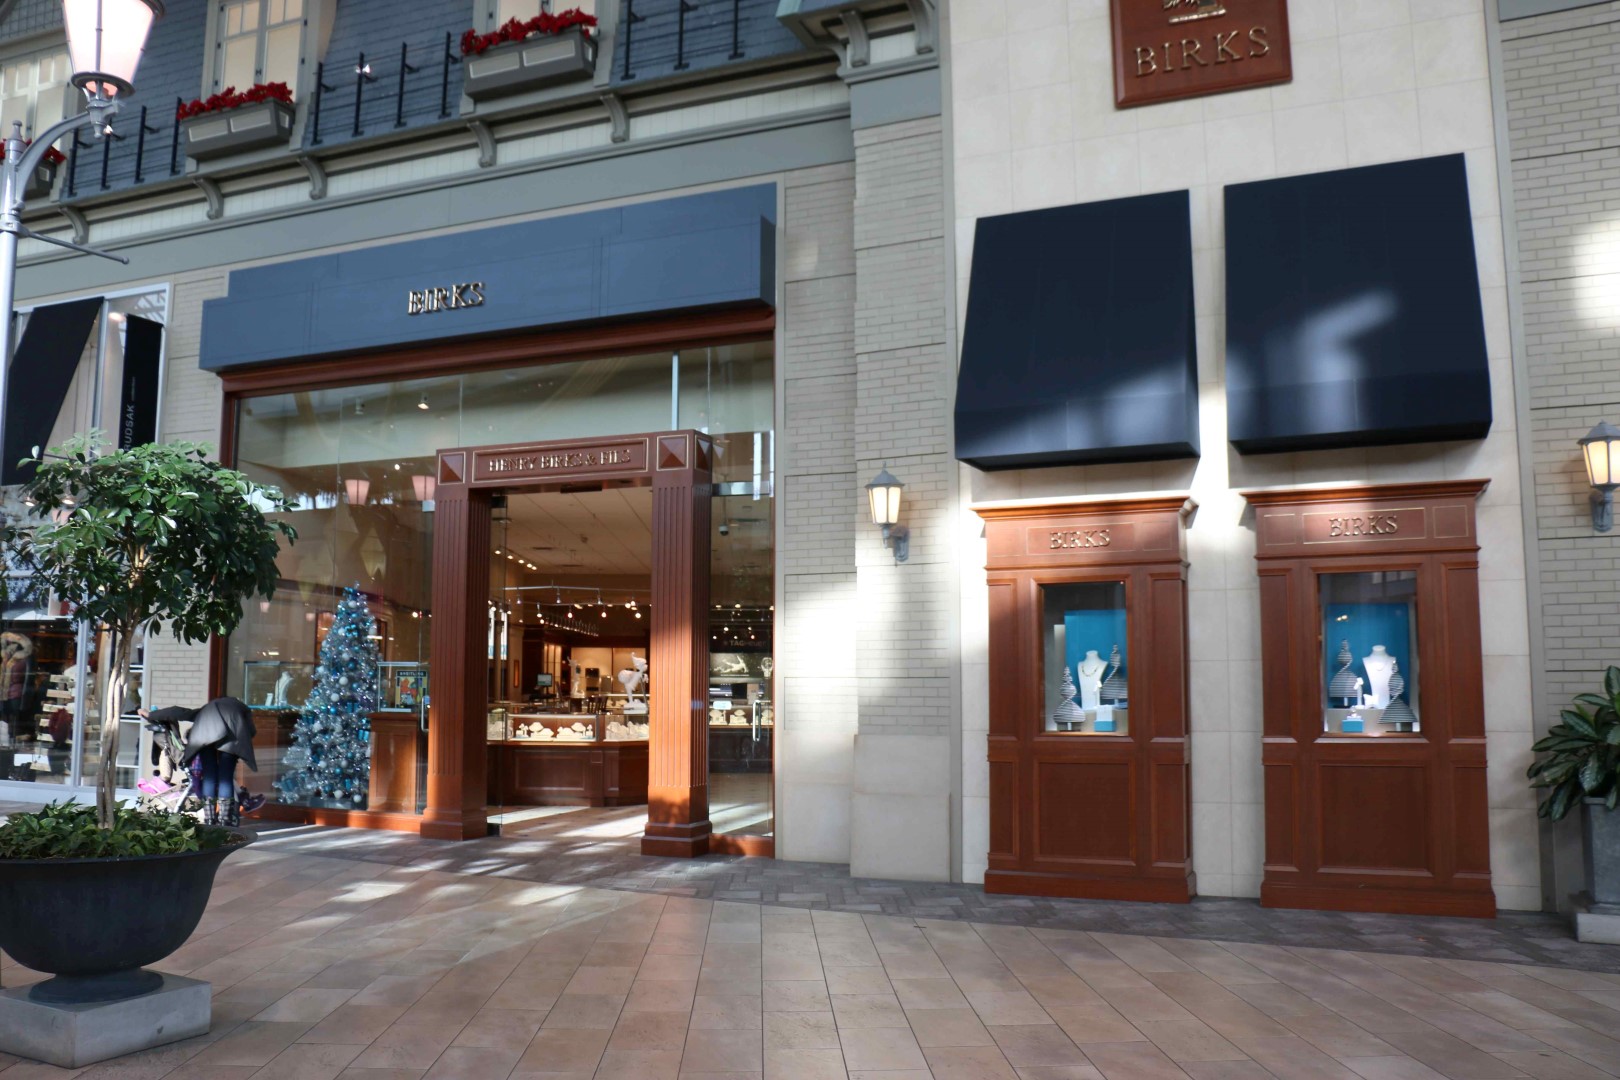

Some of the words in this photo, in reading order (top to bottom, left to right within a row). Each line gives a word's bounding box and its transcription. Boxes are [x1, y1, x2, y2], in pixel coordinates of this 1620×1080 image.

[1135, 26, 1270, 77] BIRKS
[408, 282, 484, 315] BIRKS
[124, 404, 135, 452] RUDSAK
[489, 456, 537, 472] HENRY
[540, 452, 583, 469] BIRKS
[585, 452, 598, 466] &
[600, 448, 631, 465] FILS
[1049, 529, 1111, 549] BIRKS
[1331, 515, 1398, 537] BIRKS
